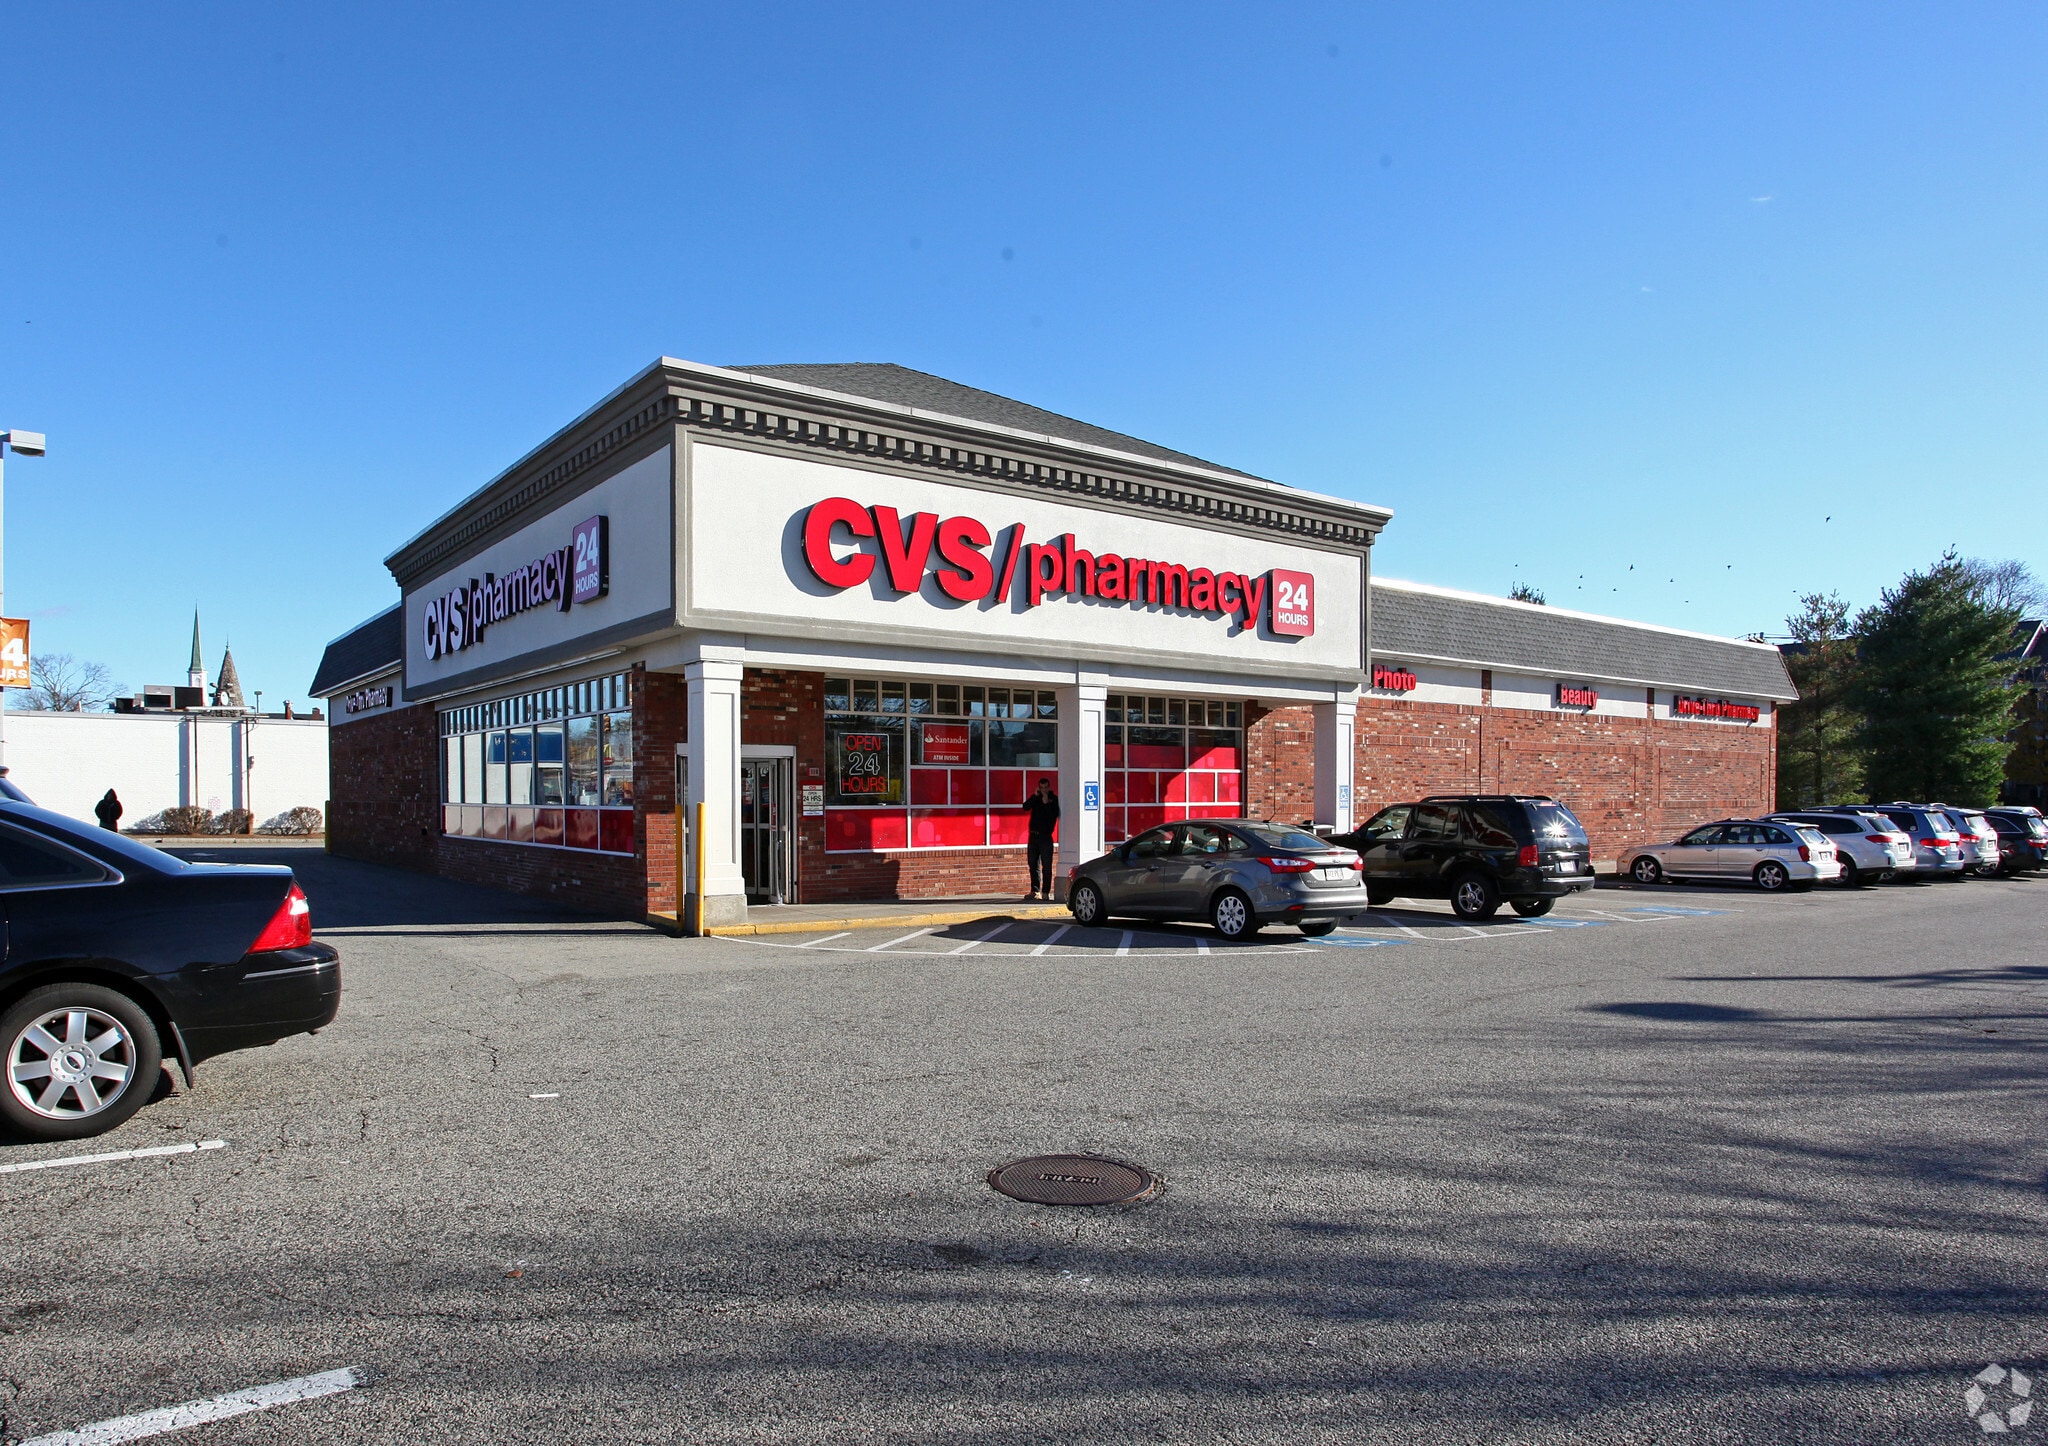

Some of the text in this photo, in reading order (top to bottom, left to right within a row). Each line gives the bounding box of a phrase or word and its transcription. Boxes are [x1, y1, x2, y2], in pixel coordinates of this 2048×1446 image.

[575, 526, 598, 574] 24
[803, 496, 1265, 631] CVS/pharmacy
[575, 571, 598, 594] HOURS
[423, 545, 572, 660] CVS/pharmacy
[1278, 581, 1308, 612] 24
[1278, 611, 1309, 626] HOURS
[1373, 664, 1416, 691] Photo
[1560, 683, 1598, 710] Beauty
[1721, 700, 1760, 723] Pharmacy
[845, 735, 882, 751] OPEN
[934, 734, 968, 745] Santander
[848, 751, 880, 776] 24
[841, 776, 887, 793] HOURS
